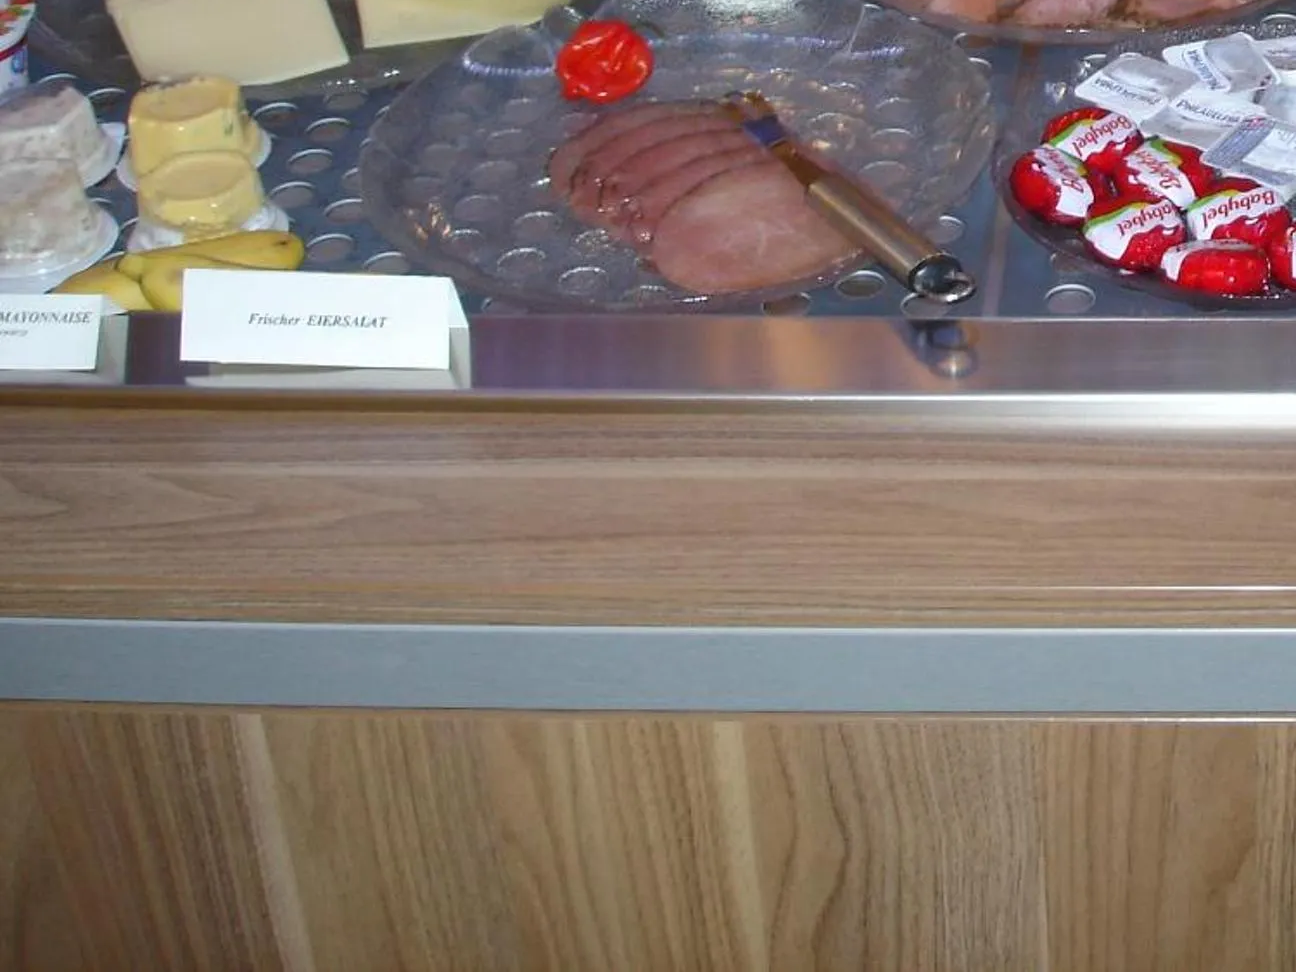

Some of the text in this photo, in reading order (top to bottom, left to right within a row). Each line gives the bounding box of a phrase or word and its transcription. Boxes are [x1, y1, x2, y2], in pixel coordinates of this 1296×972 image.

[1072, 114, 1133, 158] Babybel
[1116, 201, 1177, 238] abybel
[1201, 189, 1277, 229] Babybel
[0, 310, 93, 325] MAYONNAISE
[248, 312, 388, 328] Frischer EIERSALAT
